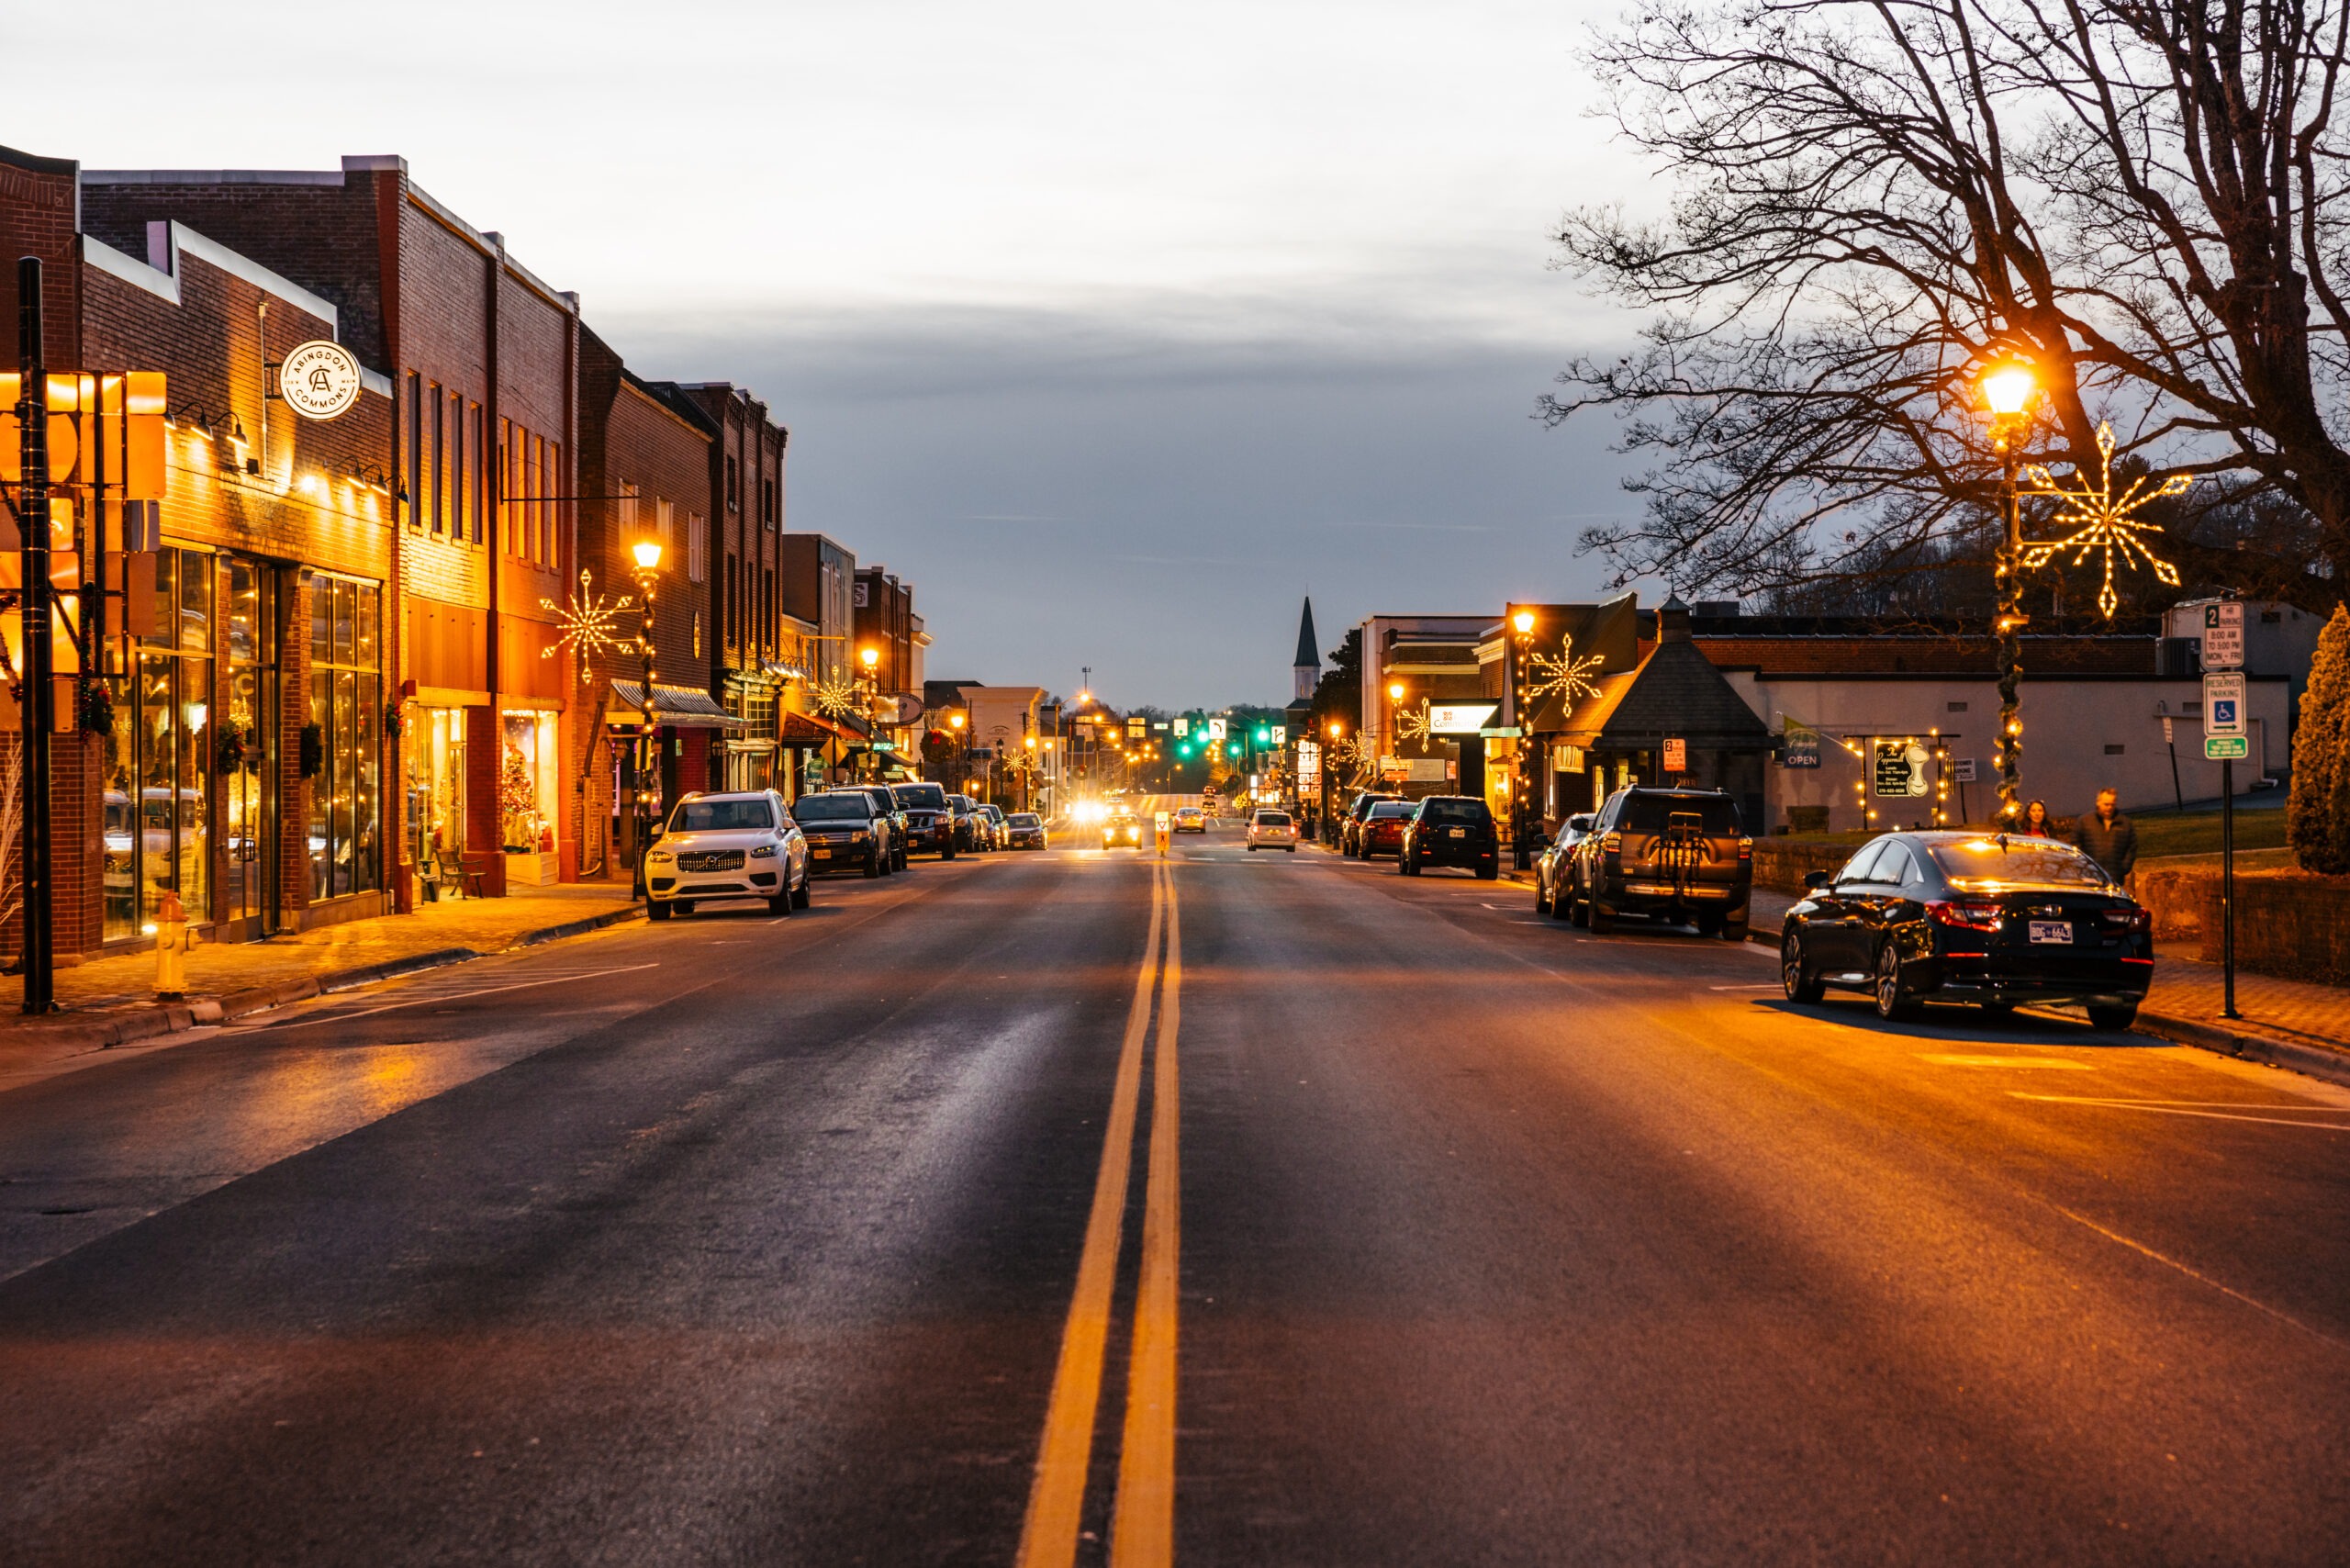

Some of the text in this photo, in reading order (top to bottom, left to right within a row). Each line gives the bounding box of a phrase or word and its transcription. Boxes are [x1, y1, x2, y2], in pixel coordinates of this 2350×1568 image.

[294, 351, 347, 374] ABINGDON
[296, 386, 347, 409] COMMONS
[2209, 607, 2234, 625] 2 HR
[2220, 617, 2241, 625] PARKING
[2210, 631, 2237, 640] 8:00 AM
[2208, 641, 2240, 651] TO 5:00 PM
[2207, 652, 2222, 661] MON
[2230, 652, 2241, 660] FRI
[2207, 678, 2241, 689] RESERVED
[2210, 689, 2239, 699] PARKING
[1787, 756, 1817, 765] OPEN
